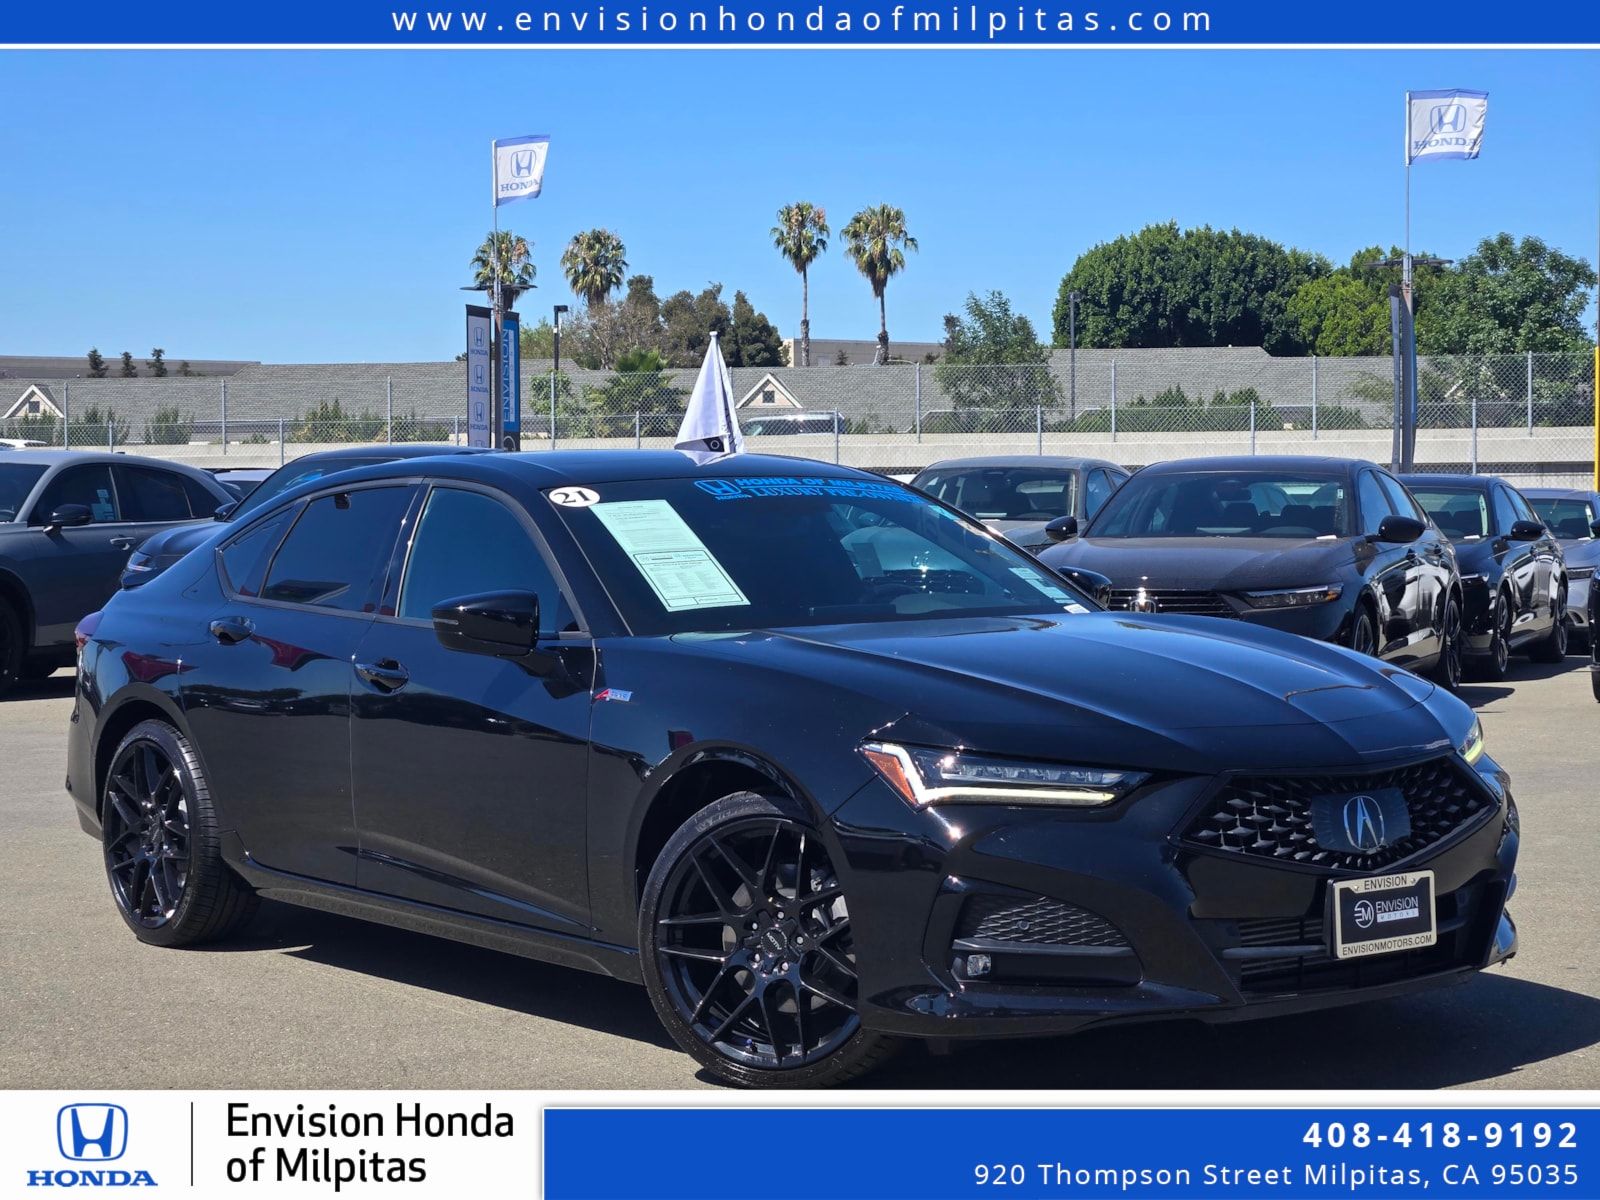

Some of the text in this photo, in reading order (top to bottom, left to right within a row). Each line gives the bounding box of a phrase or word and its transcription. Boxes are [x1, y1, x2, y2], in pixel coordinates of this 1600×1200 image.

[503, 328, 511, 423] ENVISION
[735, 478, 802, 486] HONDA
[553, 490, 591, 504] 21
[748, 486, 824, 497] LUXURY
[1364, 875, 1408, 891] ENVISION
[1376, 896, 1419, 913] ENVISION
[1342, 934, 1433, 956] ENVISIONMOTORS.COM
